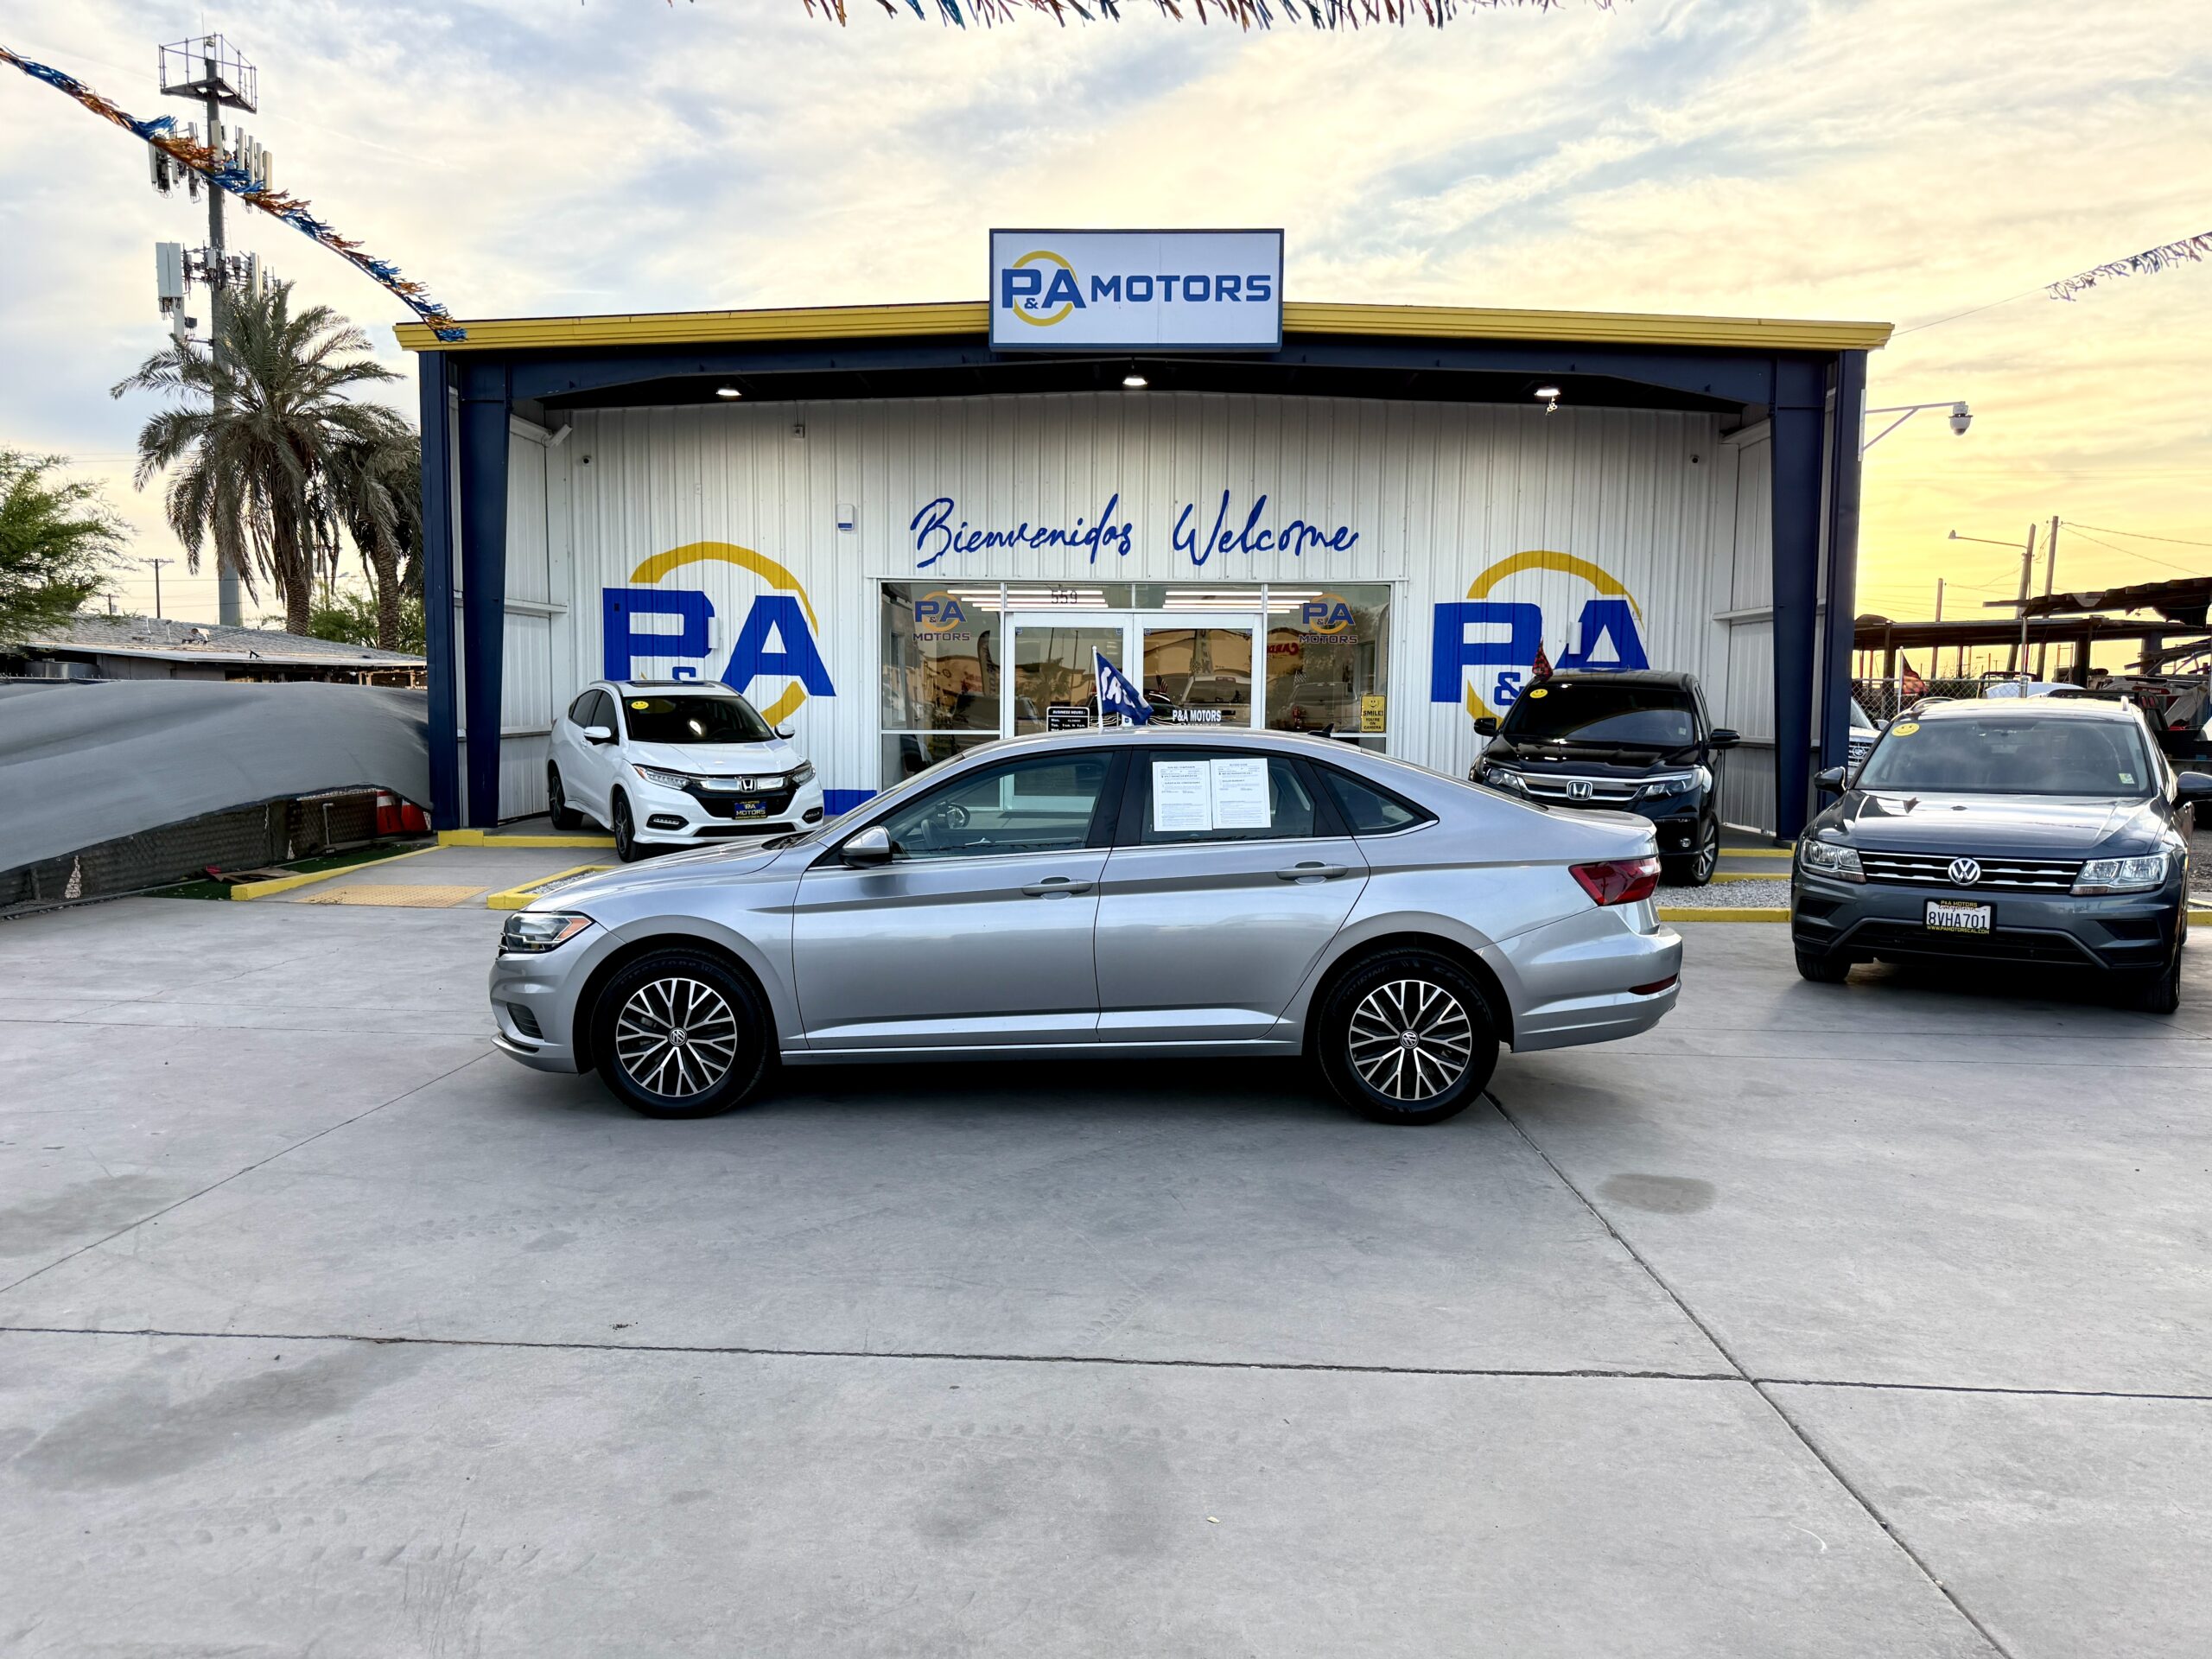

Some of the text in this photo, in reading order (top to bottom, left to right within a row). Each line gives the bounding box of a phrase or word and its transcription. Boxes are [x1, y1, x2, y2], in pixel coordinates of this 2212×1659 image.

[1090, 275, 1271, 302] MOTORS
[910, 489, 1359, 569] Bienvenidos Welcome
[1051, 589, 1077, 604] 559
[912, 632, 970, 641] MOTORS
[1299, 635, 1358, 644] MOTORS
[1172, 709, 1222, 722] P&A MOTORS
[1928, 911, 1986, 929] 8VHA701
